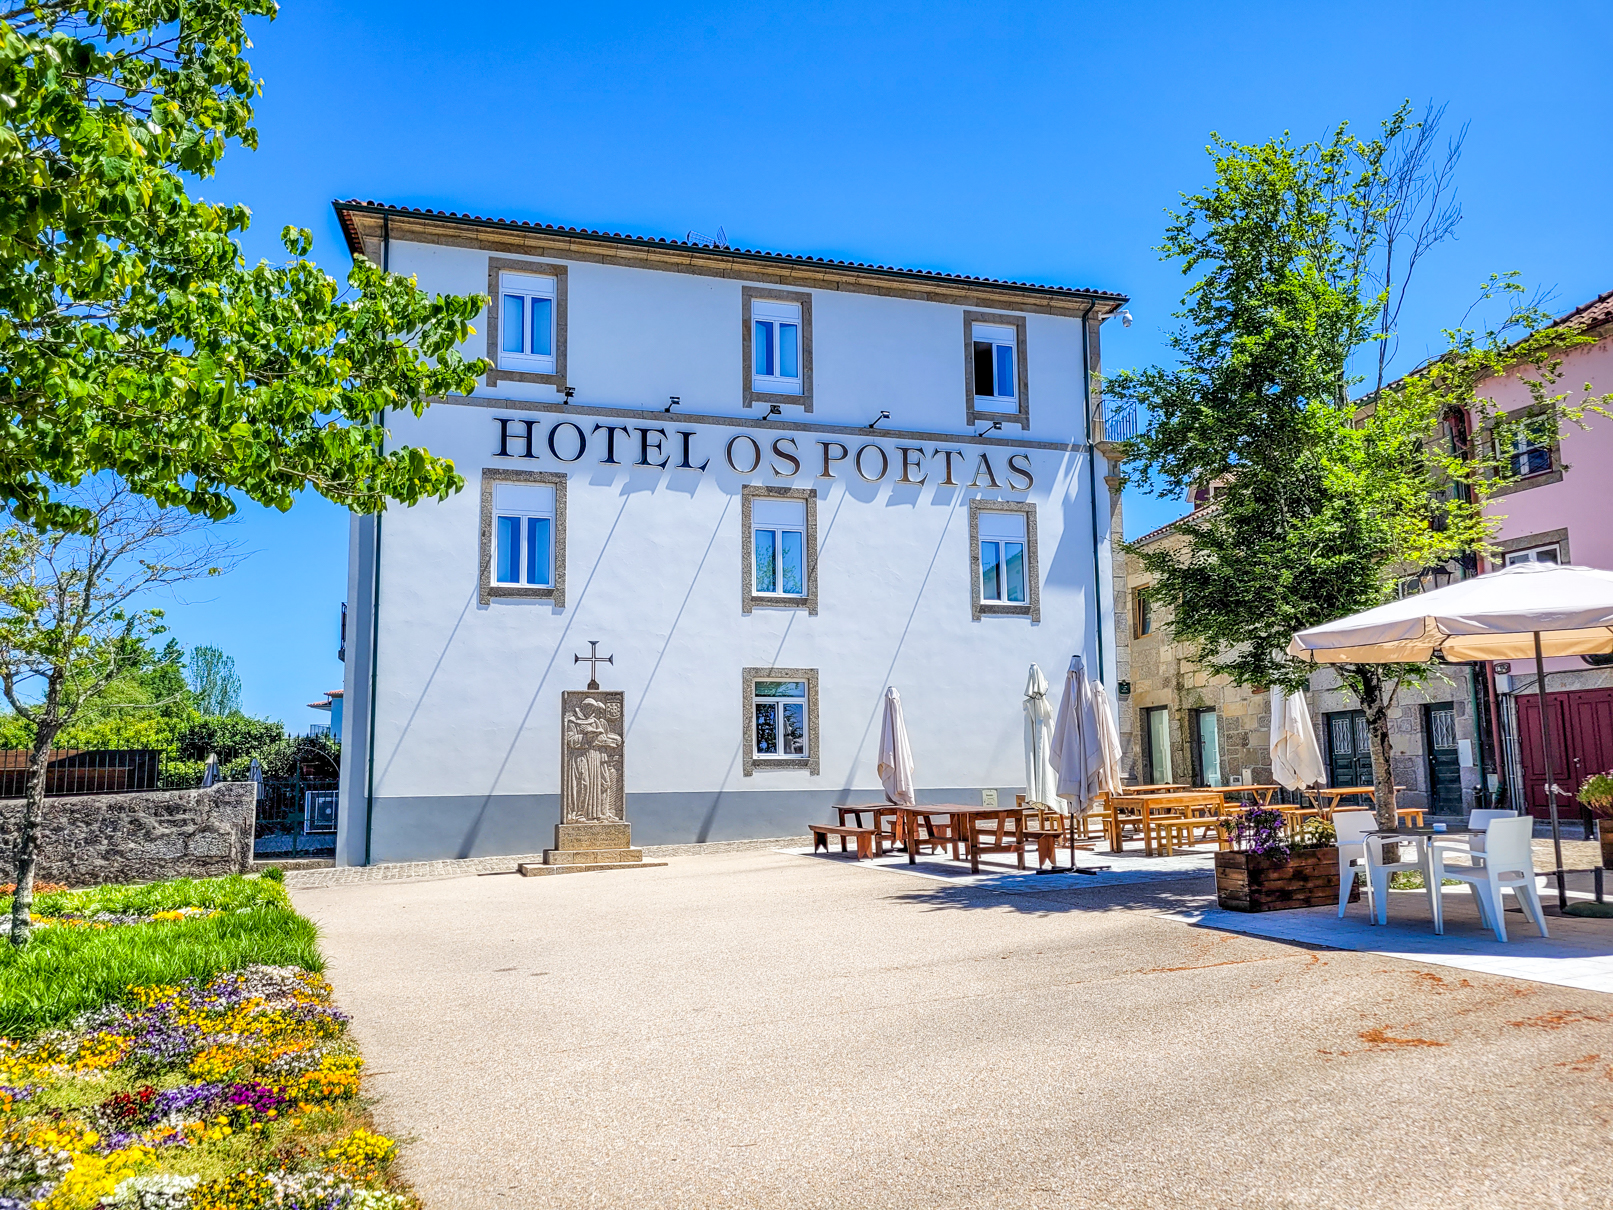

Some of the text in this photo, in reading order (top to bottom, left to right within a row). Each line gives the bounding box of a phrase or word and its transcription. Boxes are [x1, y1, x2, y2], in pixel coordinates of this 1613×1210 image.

[492, 417, 1034, 492] HOTEL OS POETAS
